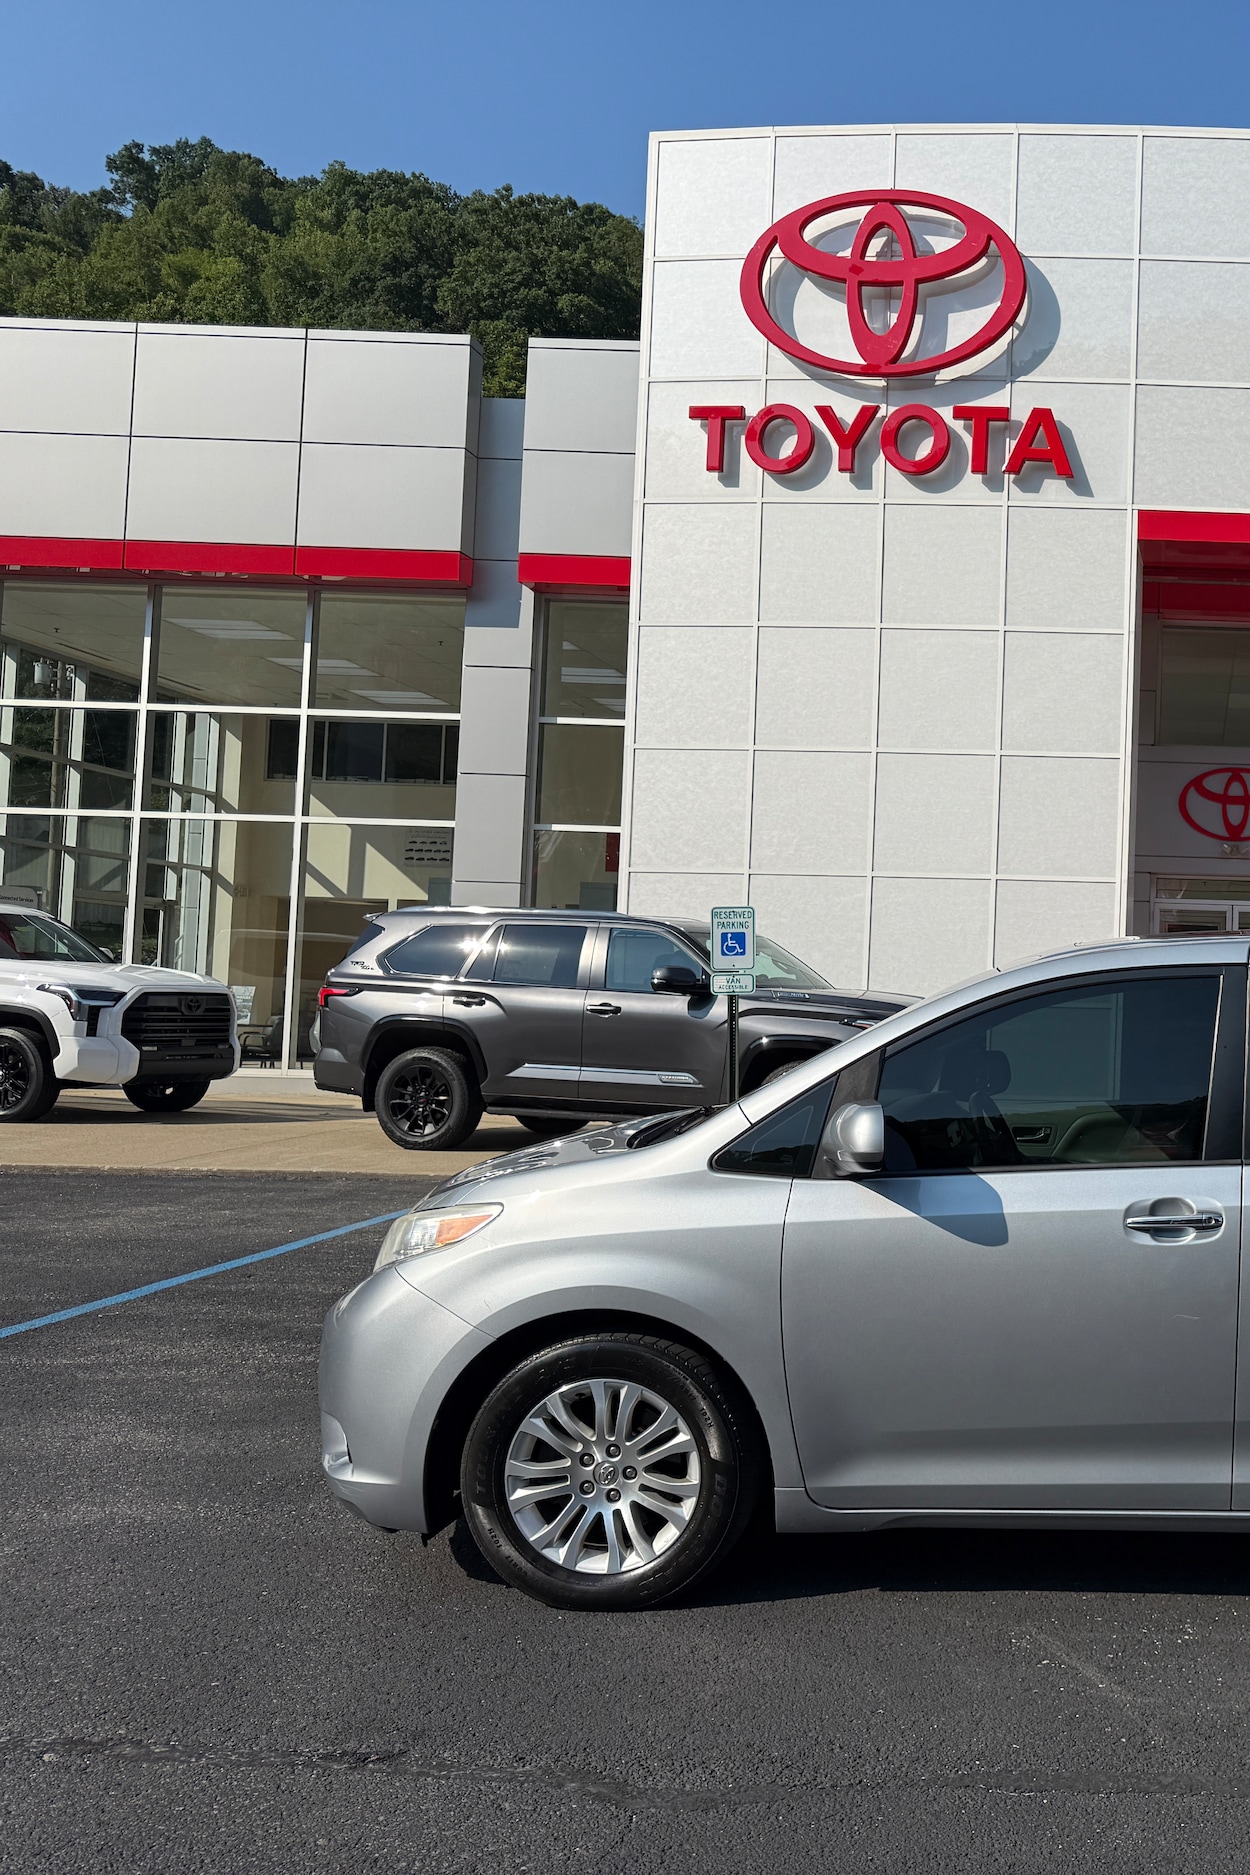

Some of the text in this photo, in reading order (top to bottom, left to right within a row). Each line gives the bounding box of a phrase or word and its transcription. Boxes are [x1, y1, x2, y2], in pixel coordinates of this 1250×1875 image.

[688, 403, 1074, 478] TOYOTA
[713, 910, 752, 919] RESERVED
[716, 921, 750, 930] PARKING
